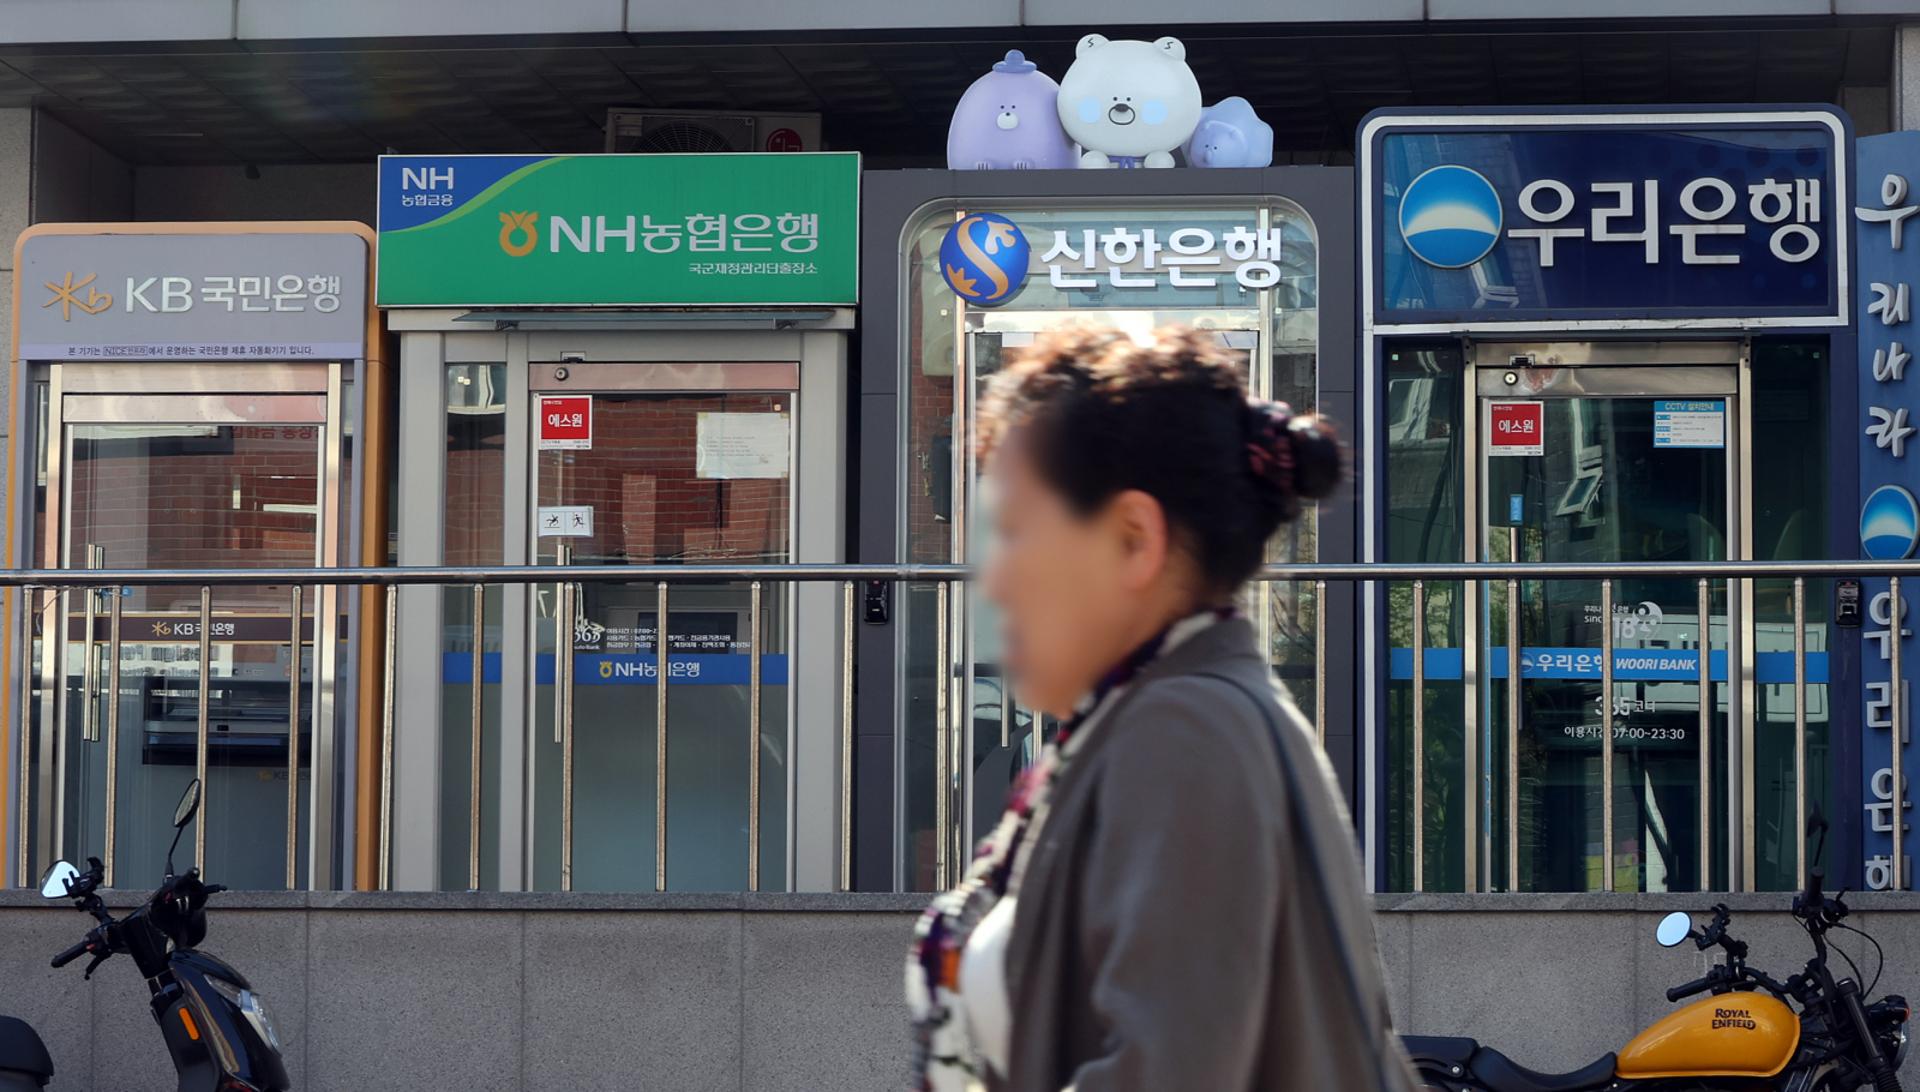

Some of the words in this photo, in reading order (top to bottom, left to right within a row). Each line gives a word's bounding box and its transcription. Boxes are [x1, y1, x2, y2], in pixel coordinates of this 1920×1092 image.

[402, 167, 454, 190] NH
[402, 194, 453, 207] 농협금융
[1508, 177, 1821, 267] 우리은행
[550, 213, 820, 253] NH농협은행
[1041, 226, 1282, 289] 신한은행
[1855, 174, 1919, 457] 우리나라
[199, 346, 228, 356] 국민은행
[548, 413, 582, 427] 에스원
[1498, 419, 1533, 433] 에스원
[1616, 657, 1658, 670] WOORI
[1659, 658, 1697, 670] BANK
[1633, 700, 1656, 712] 코너
[1715, 1008, 1751, 1018] ROYAL
[1712, 1019, 1756, 1030] ENFIELD
